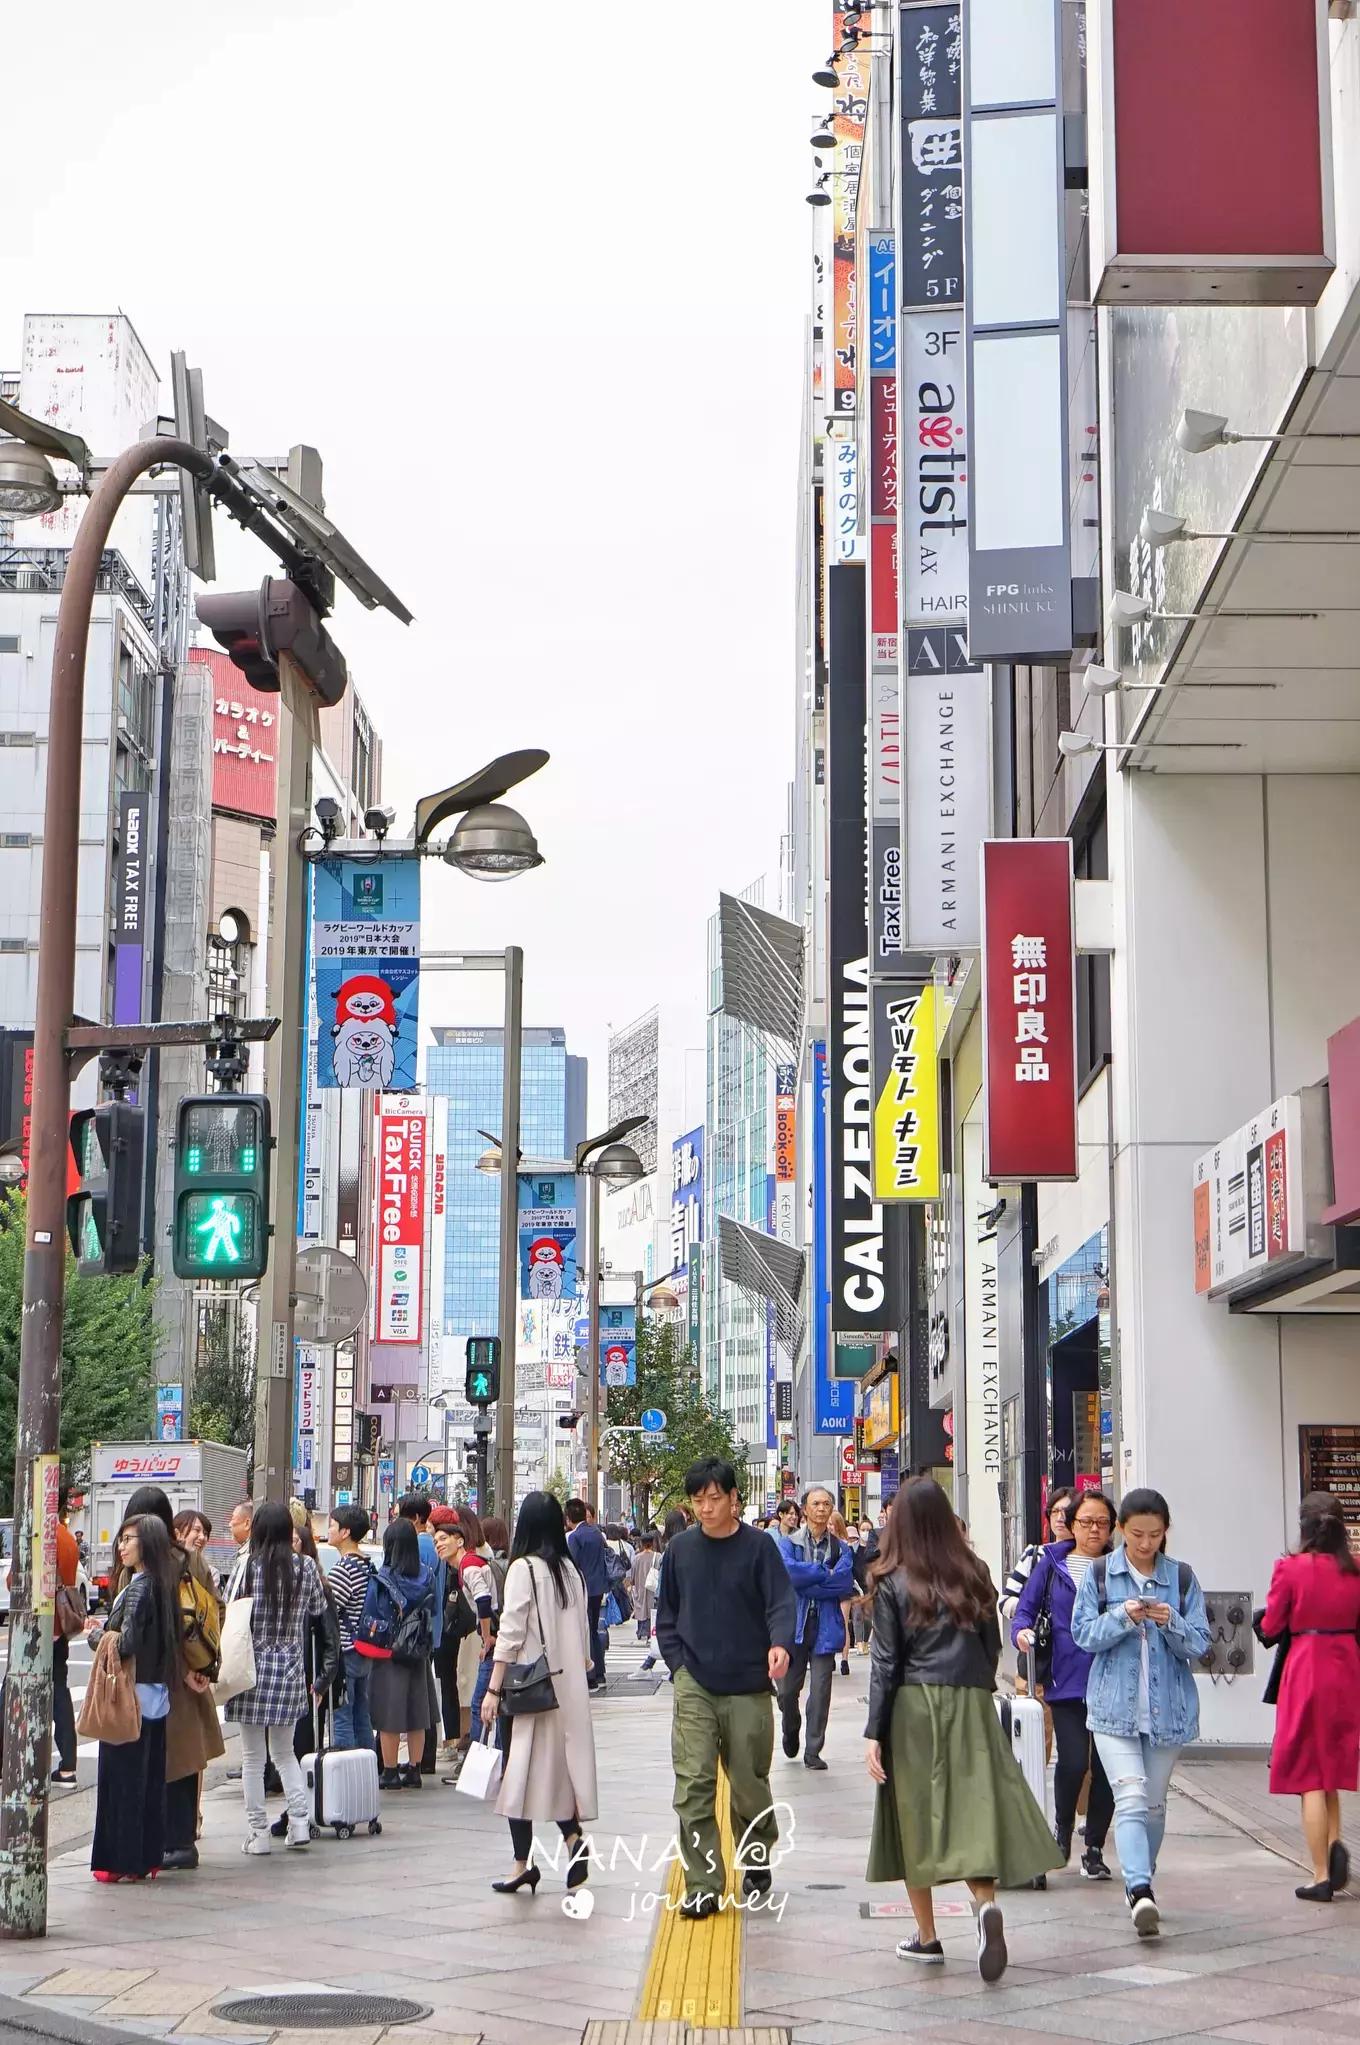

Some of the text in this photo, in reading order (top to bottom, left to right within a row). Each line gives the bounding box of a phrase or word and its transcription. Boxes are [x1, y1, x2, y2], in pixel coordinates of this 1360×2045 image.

[919, 187, 944, 270] ダイニング
[926, 277, 958, 297] 5F
[873, 261, 896, 364] イーオン
[925, 331, 960, 356] 3F
[838, 445, 856, 558] みずのクリ
[920, 595, 968, 612] HAIR
[986, 584, 1019, 597] FPG
[215, 697, 276, 728] カラオケ
[236, 724, 251, 740] &
[939, 690, 957, 930] ARMANI EXCHANGE
[125, 859, 140, 891] TAX
[123, 895, 139, 930] FREE
[323, 923, 414, 933] ラグビーワールドカップ
[879, 908, 900, 957] Tax
[1011, 933, 1050, 1082] 無印良品
[887, 996, 921, 1188] マツモトキヨシ
[409, 1120, 422, 1171] QUICK
[842, 956, 885, 1313] CALZEDONIA
[781, 1194, 791, 1243] KEYUC
[981, 1262, 1000, 1474] ARMANI EXCHANGE
[821, 1417, 847, 1429] AOKI
[115, 1457, 181, 1472] ゆうパック
